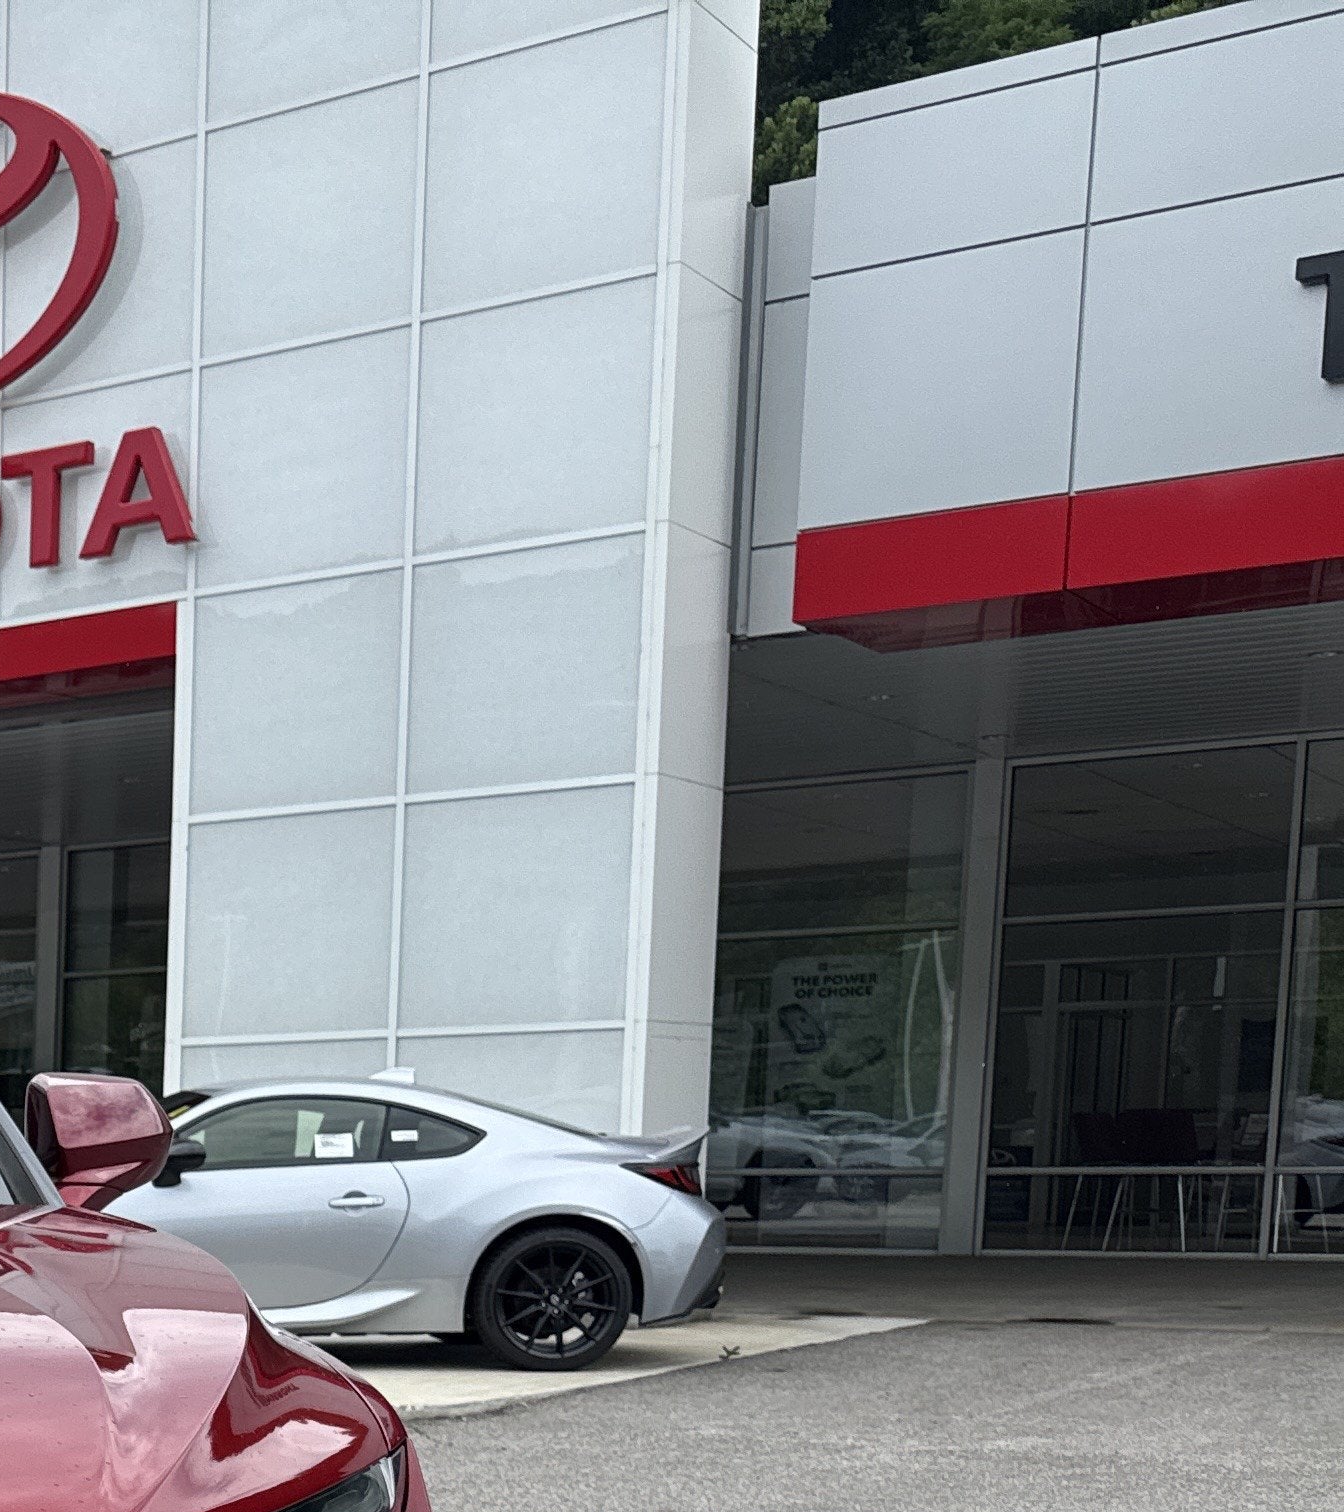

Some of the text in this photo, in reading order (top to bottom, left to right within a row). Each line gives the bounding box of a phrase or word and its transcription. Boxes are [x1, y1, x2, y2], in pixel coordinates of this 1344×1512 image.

[793, 972, 878, 986] THE POWER
[794, 985, 873, 999] OF CHOICE
